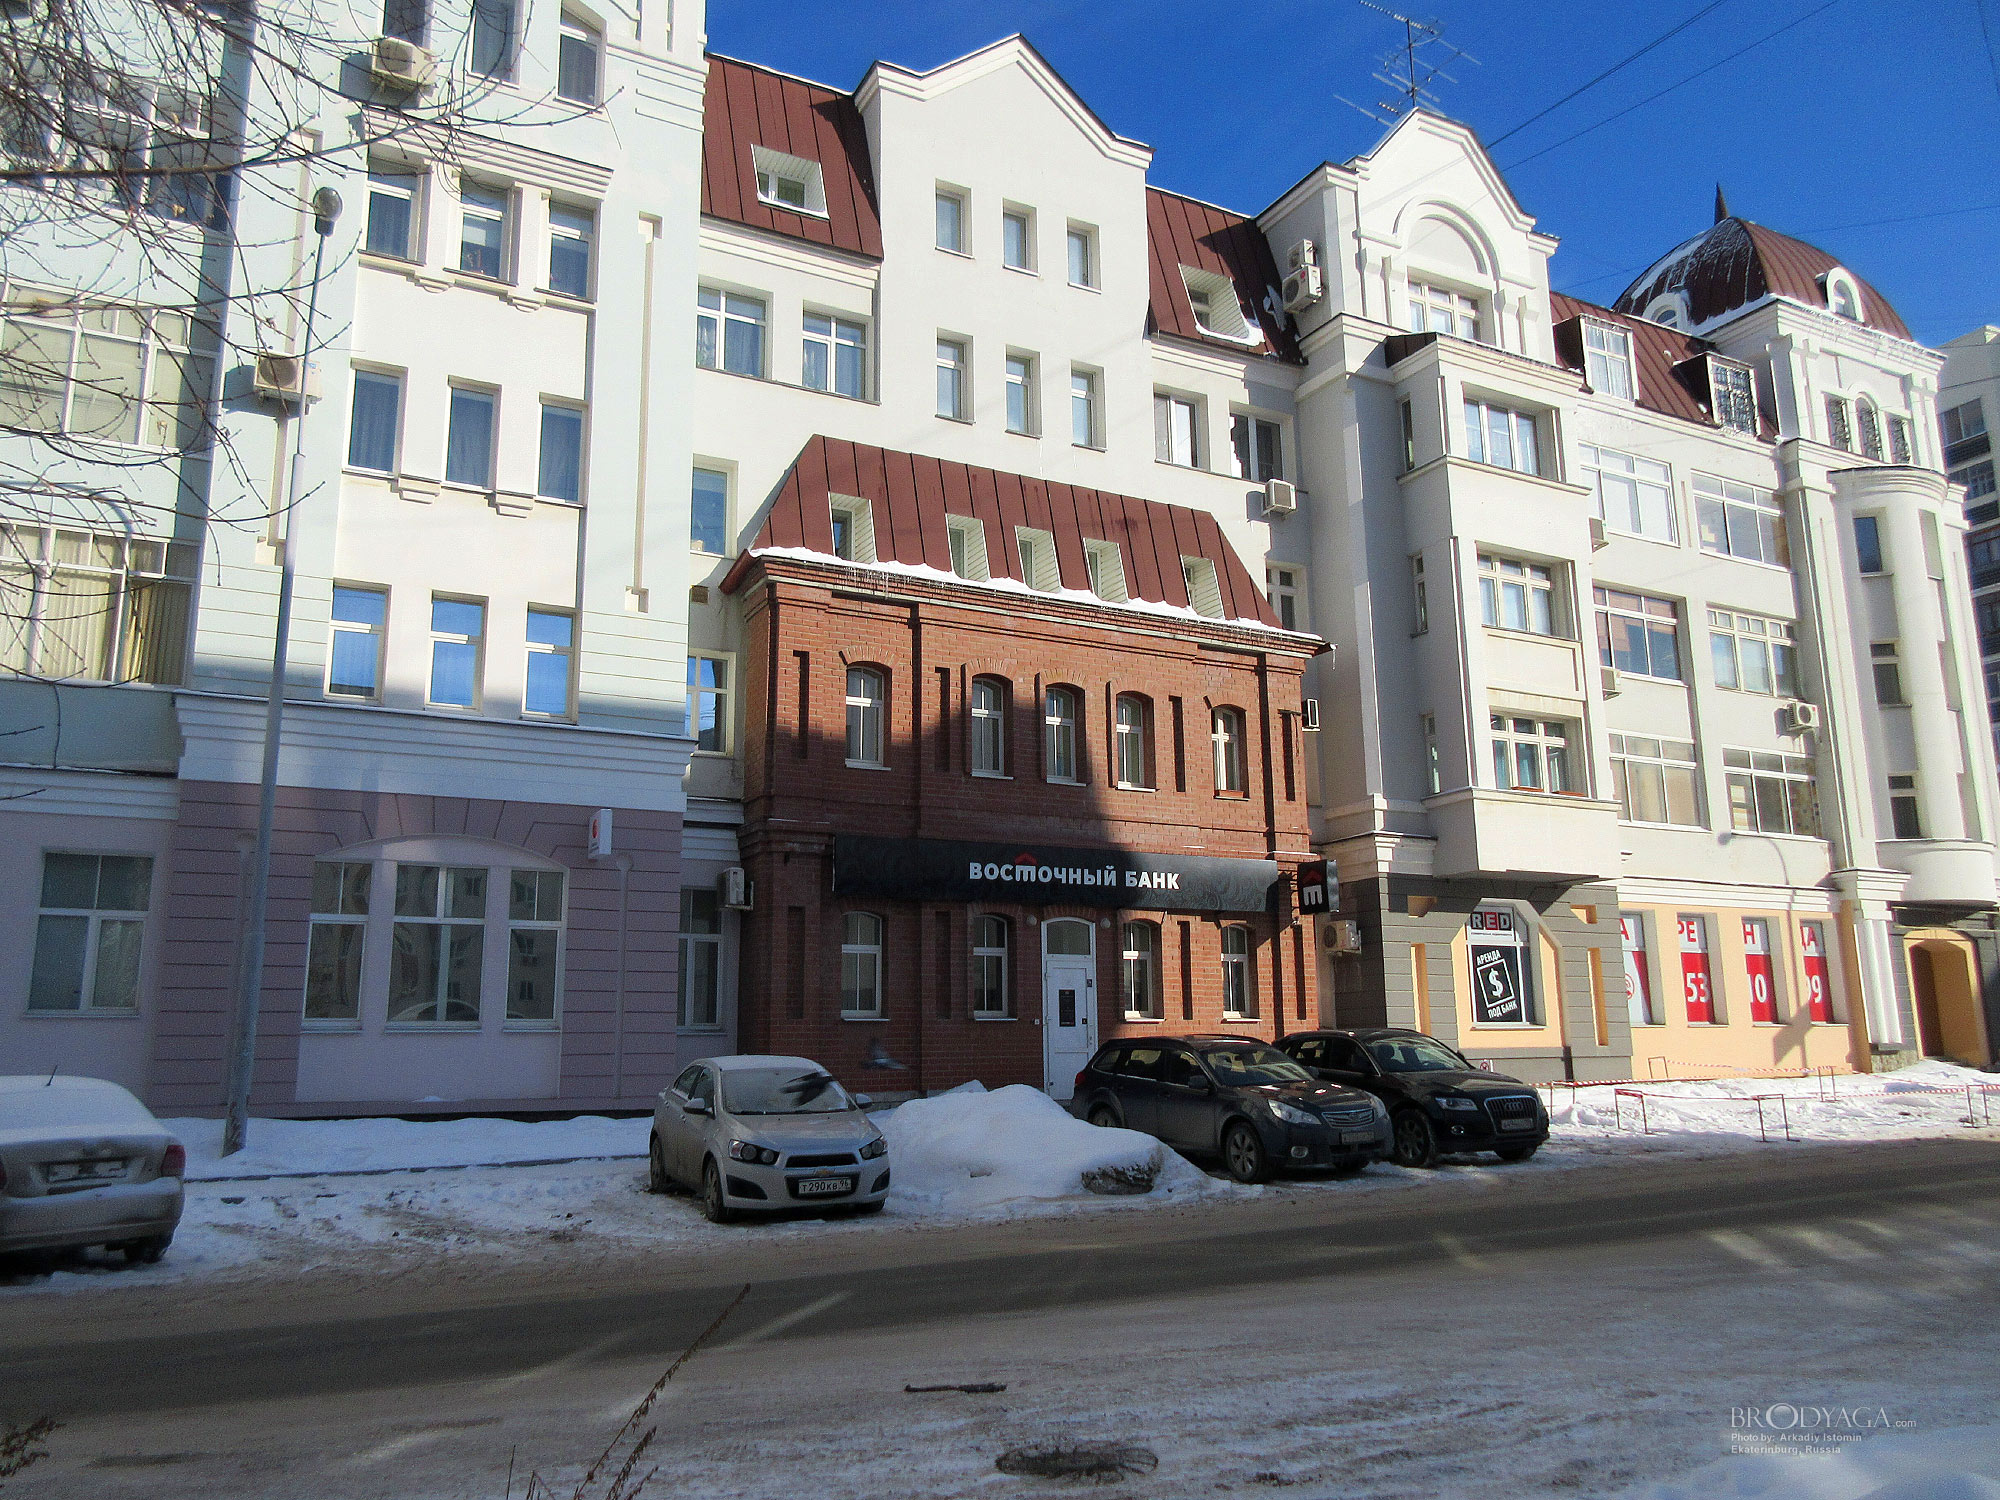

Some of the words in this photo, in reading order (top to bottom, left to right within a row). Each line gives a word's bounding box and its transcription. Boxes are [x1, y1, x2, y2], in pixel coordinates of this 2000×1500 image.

[1125, 870, 1180, 890] БАНК
[1471, 912, 1511, 929] RED
[1743, 923, 1756, 945] Н
[1476, 949, 1502, 966] АРЕНДА
[1686, 972, 1710, 1003] 53
[1487, 1003, 1503, 1019] ПОД
[1502, 999, 1518, 1014] БАНК
